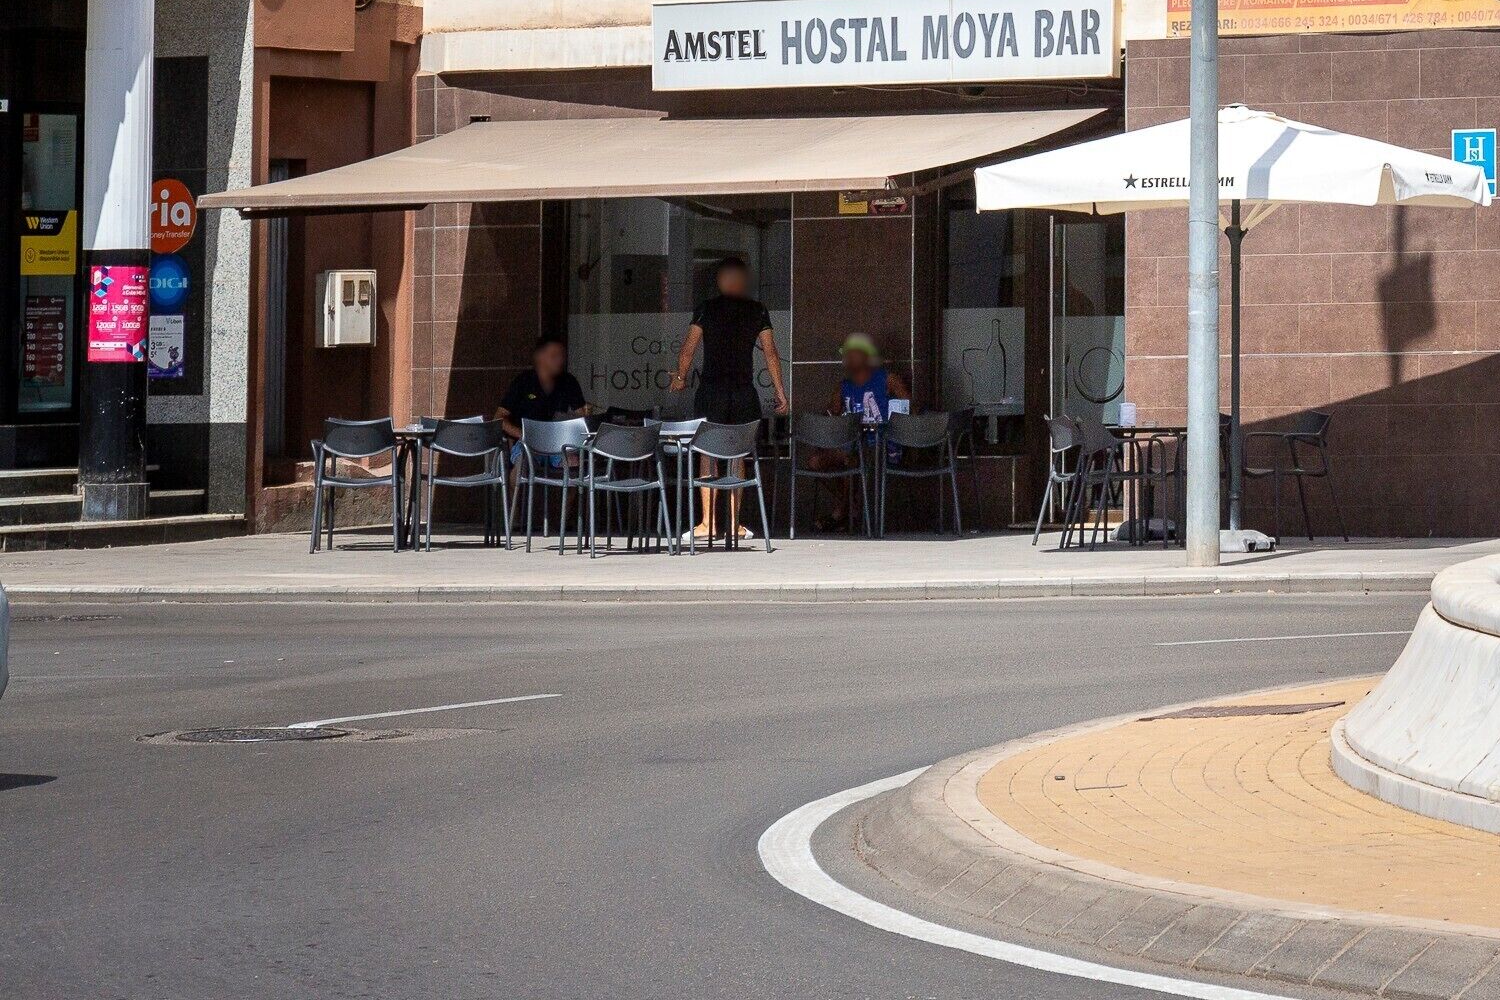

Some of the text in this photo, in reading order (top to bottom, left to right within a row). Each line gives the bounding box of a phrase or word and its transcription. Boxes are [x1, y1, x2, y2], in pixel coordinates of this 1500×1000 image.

[1295, 16, 1316, 28] 245
[1319, 15, 1339, 27] 324
[1348, 13, 1398, 26] 0034/671
[663, 8, 1101, 65] AMSTEL HOSTAL MOYA BAR
[40, 216, 59, 224] Western
[150, 230, 190, 240] oney Transfer
[150, 277, 187, 288] DIGI
[590, 364, 670, 390] Hosta
